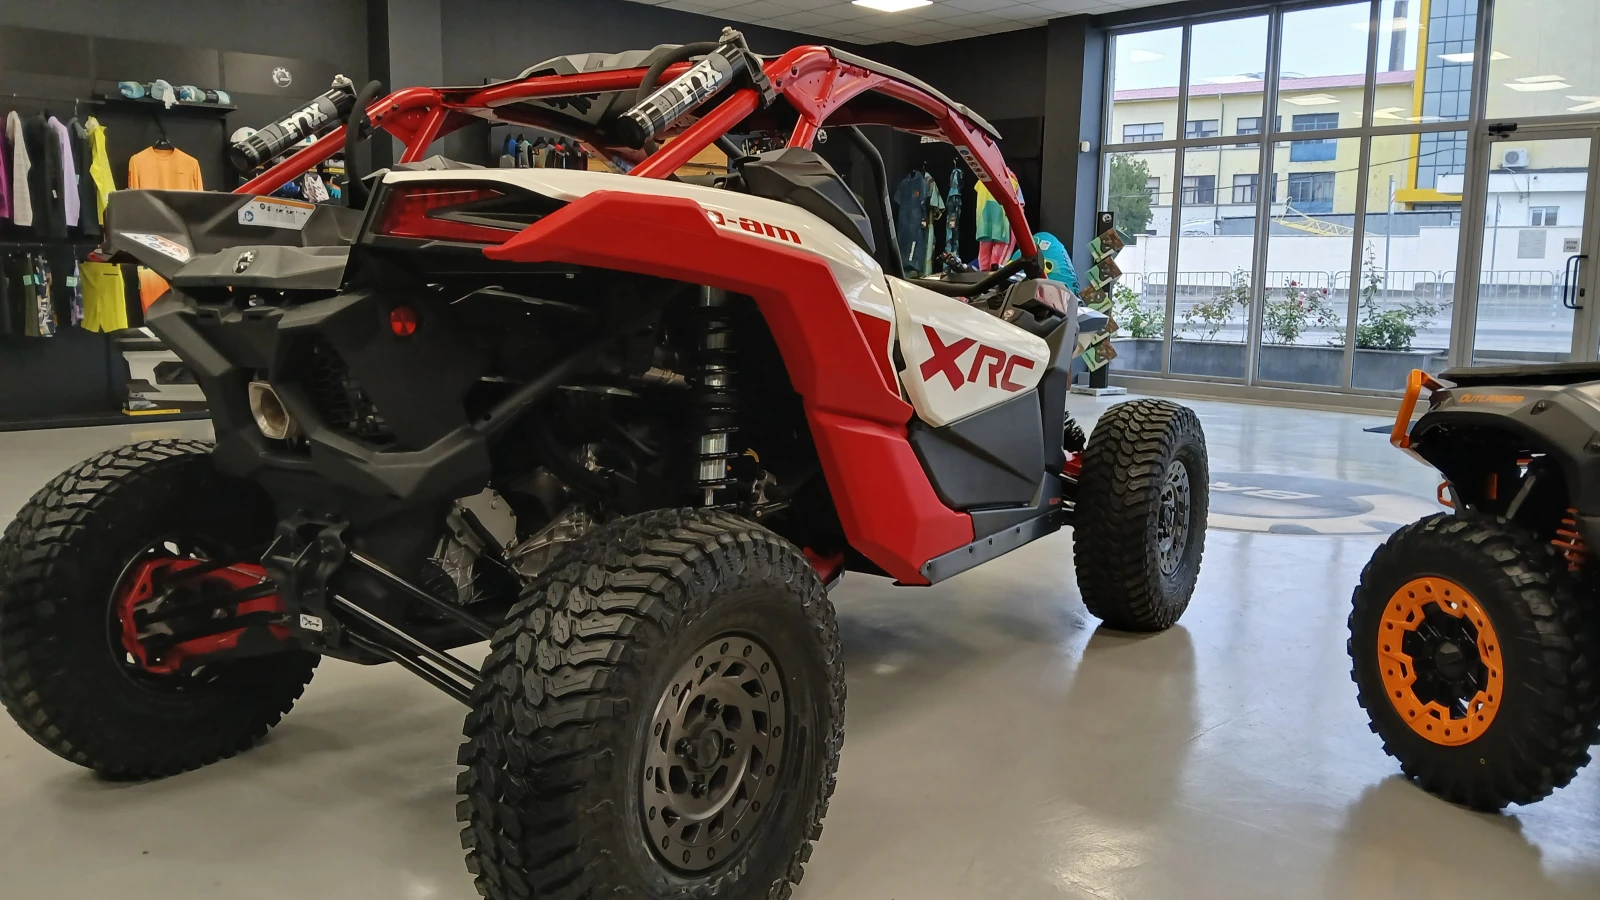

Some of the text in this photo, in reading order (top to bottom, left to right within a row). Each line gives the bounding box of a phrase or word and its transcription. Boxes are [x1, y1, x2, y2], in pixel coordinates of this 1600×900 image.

[675, 60, 722, 104] FOX
[279, 103, 328, 139] FOX
[920, 324, 1035, 392] XRC
[1459, 393, 1525, 403] OUTLANDER
